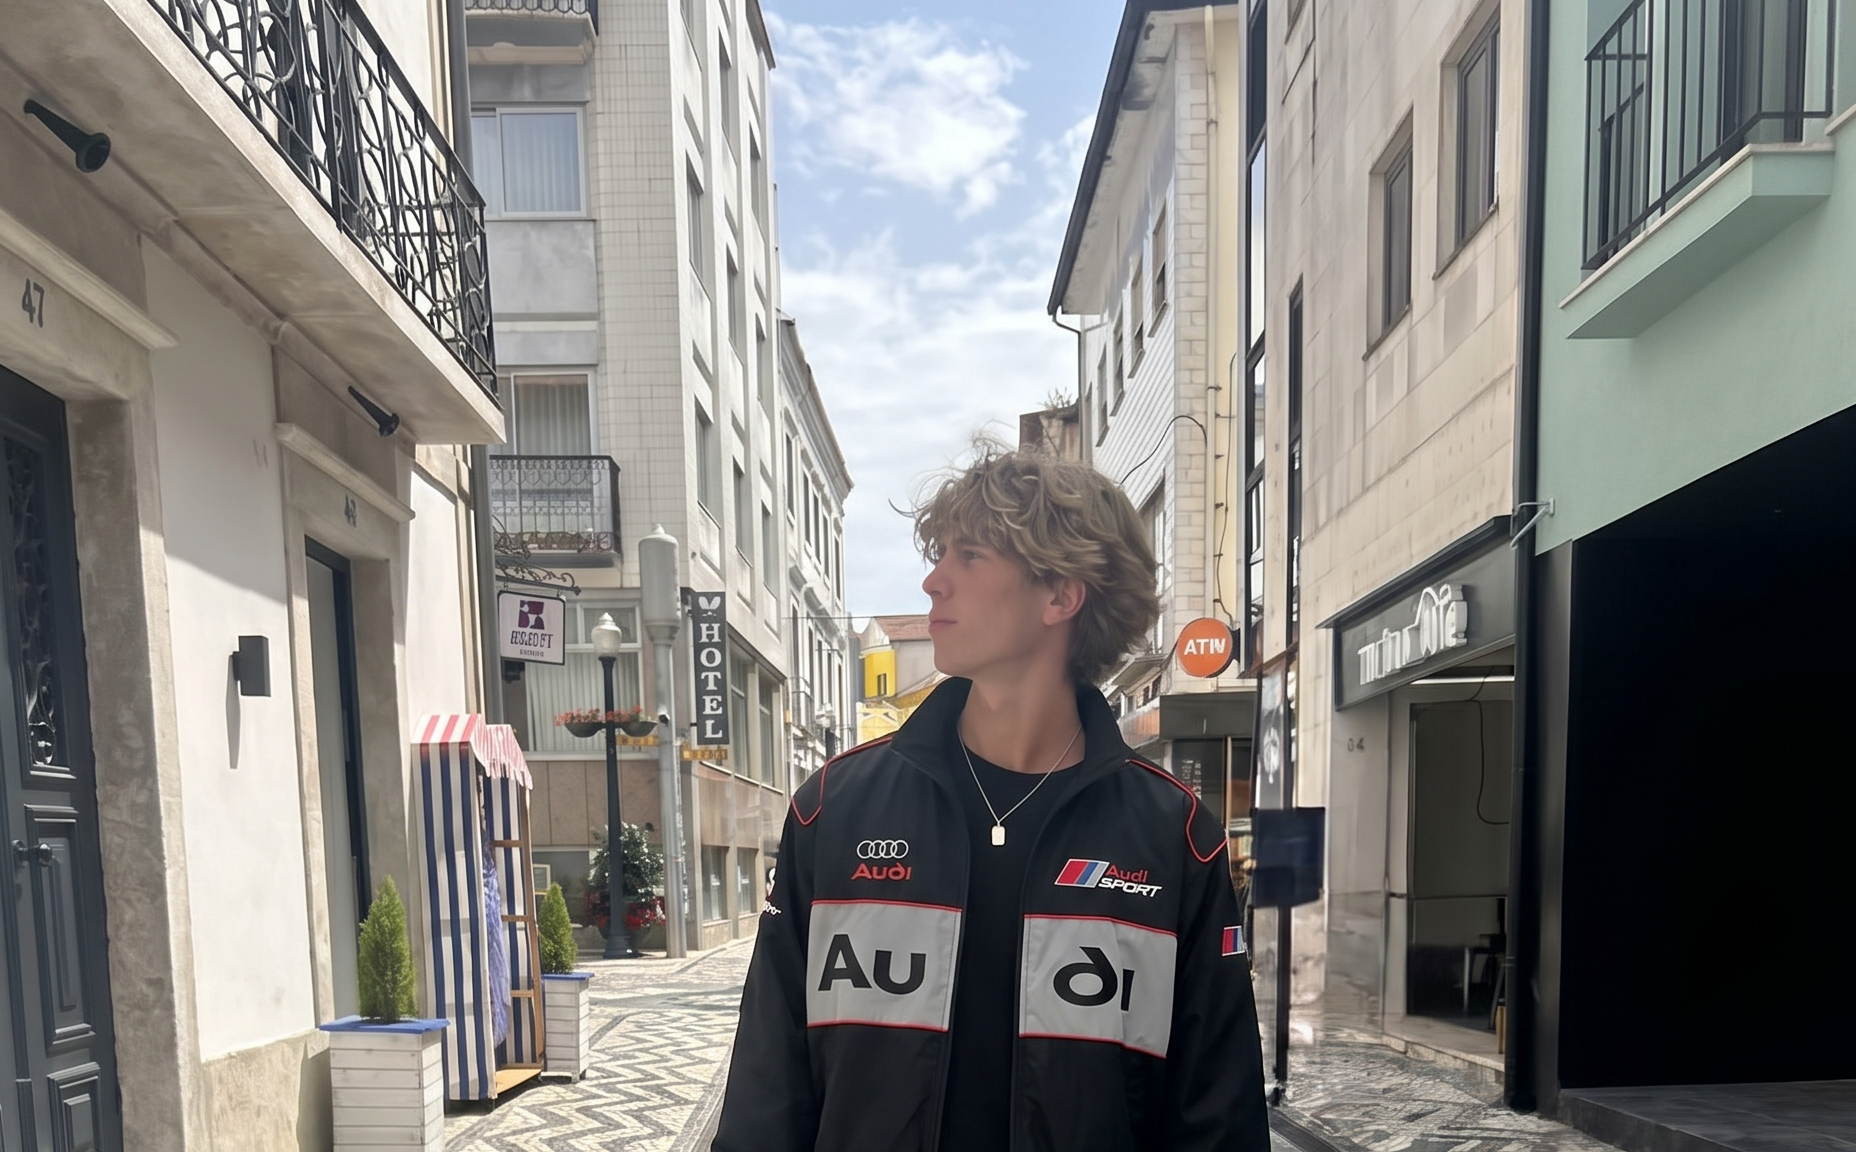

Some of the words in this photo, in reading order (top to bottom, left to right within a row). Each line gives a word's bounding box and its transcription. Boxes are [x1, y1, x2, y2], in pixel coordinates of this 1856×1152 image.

[22, 278, 45, 329] 47
[699, 623, 723, 738] HOTEL
[851, 862, 912, 880] Audi
[1105, 864, 1148, 883] Audi
[1098, 877, 1163, 898] SPORT
